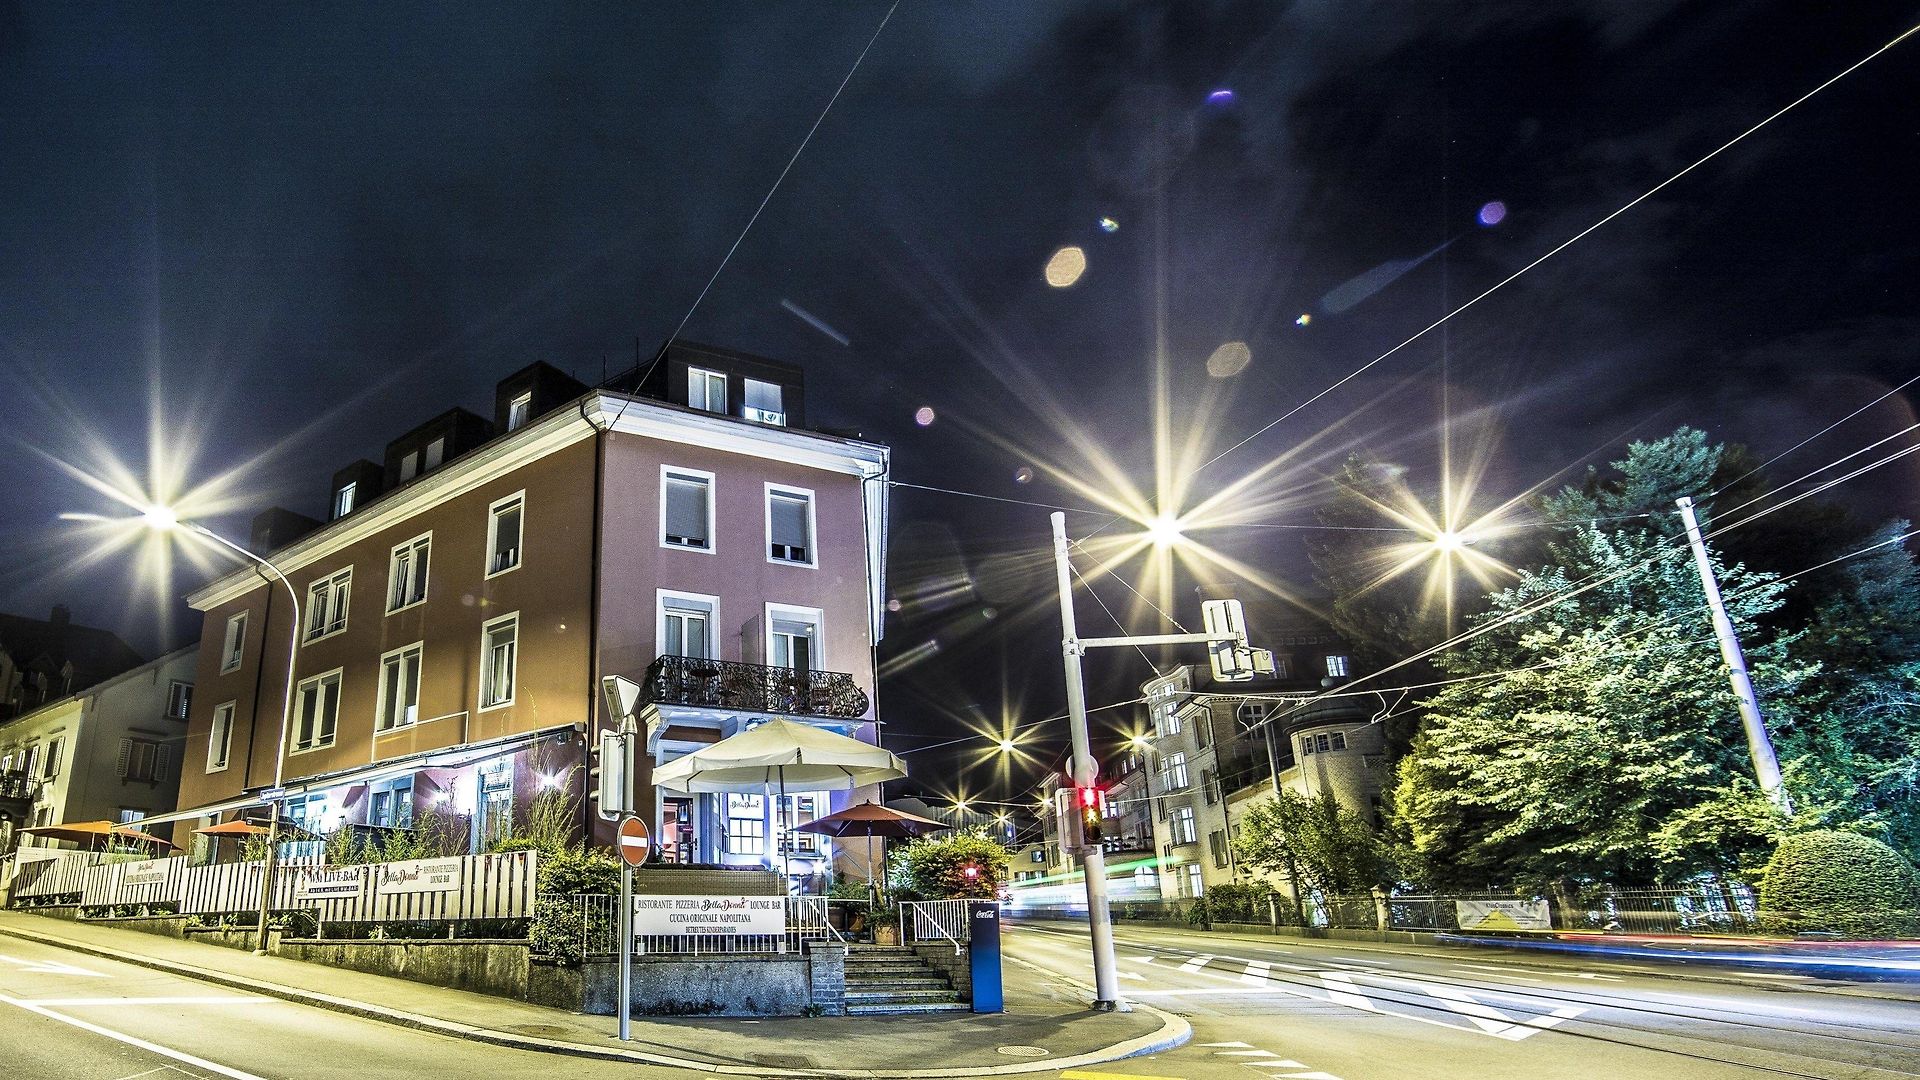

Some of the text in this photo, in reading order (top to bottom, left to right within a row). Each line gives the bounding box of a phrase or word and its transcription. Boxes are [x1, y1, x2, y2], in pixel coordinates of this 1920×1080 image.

[638, 899, 672, 909] RISTORANTE
[675, 899, 700, 909] PIZZERIA
[750, 900, 770, 909] LOUNGE
[771, 900, 781, 909] BAR
[669, 913, 751, 923] CUCINA ORIGINALE NAPOLITANA
